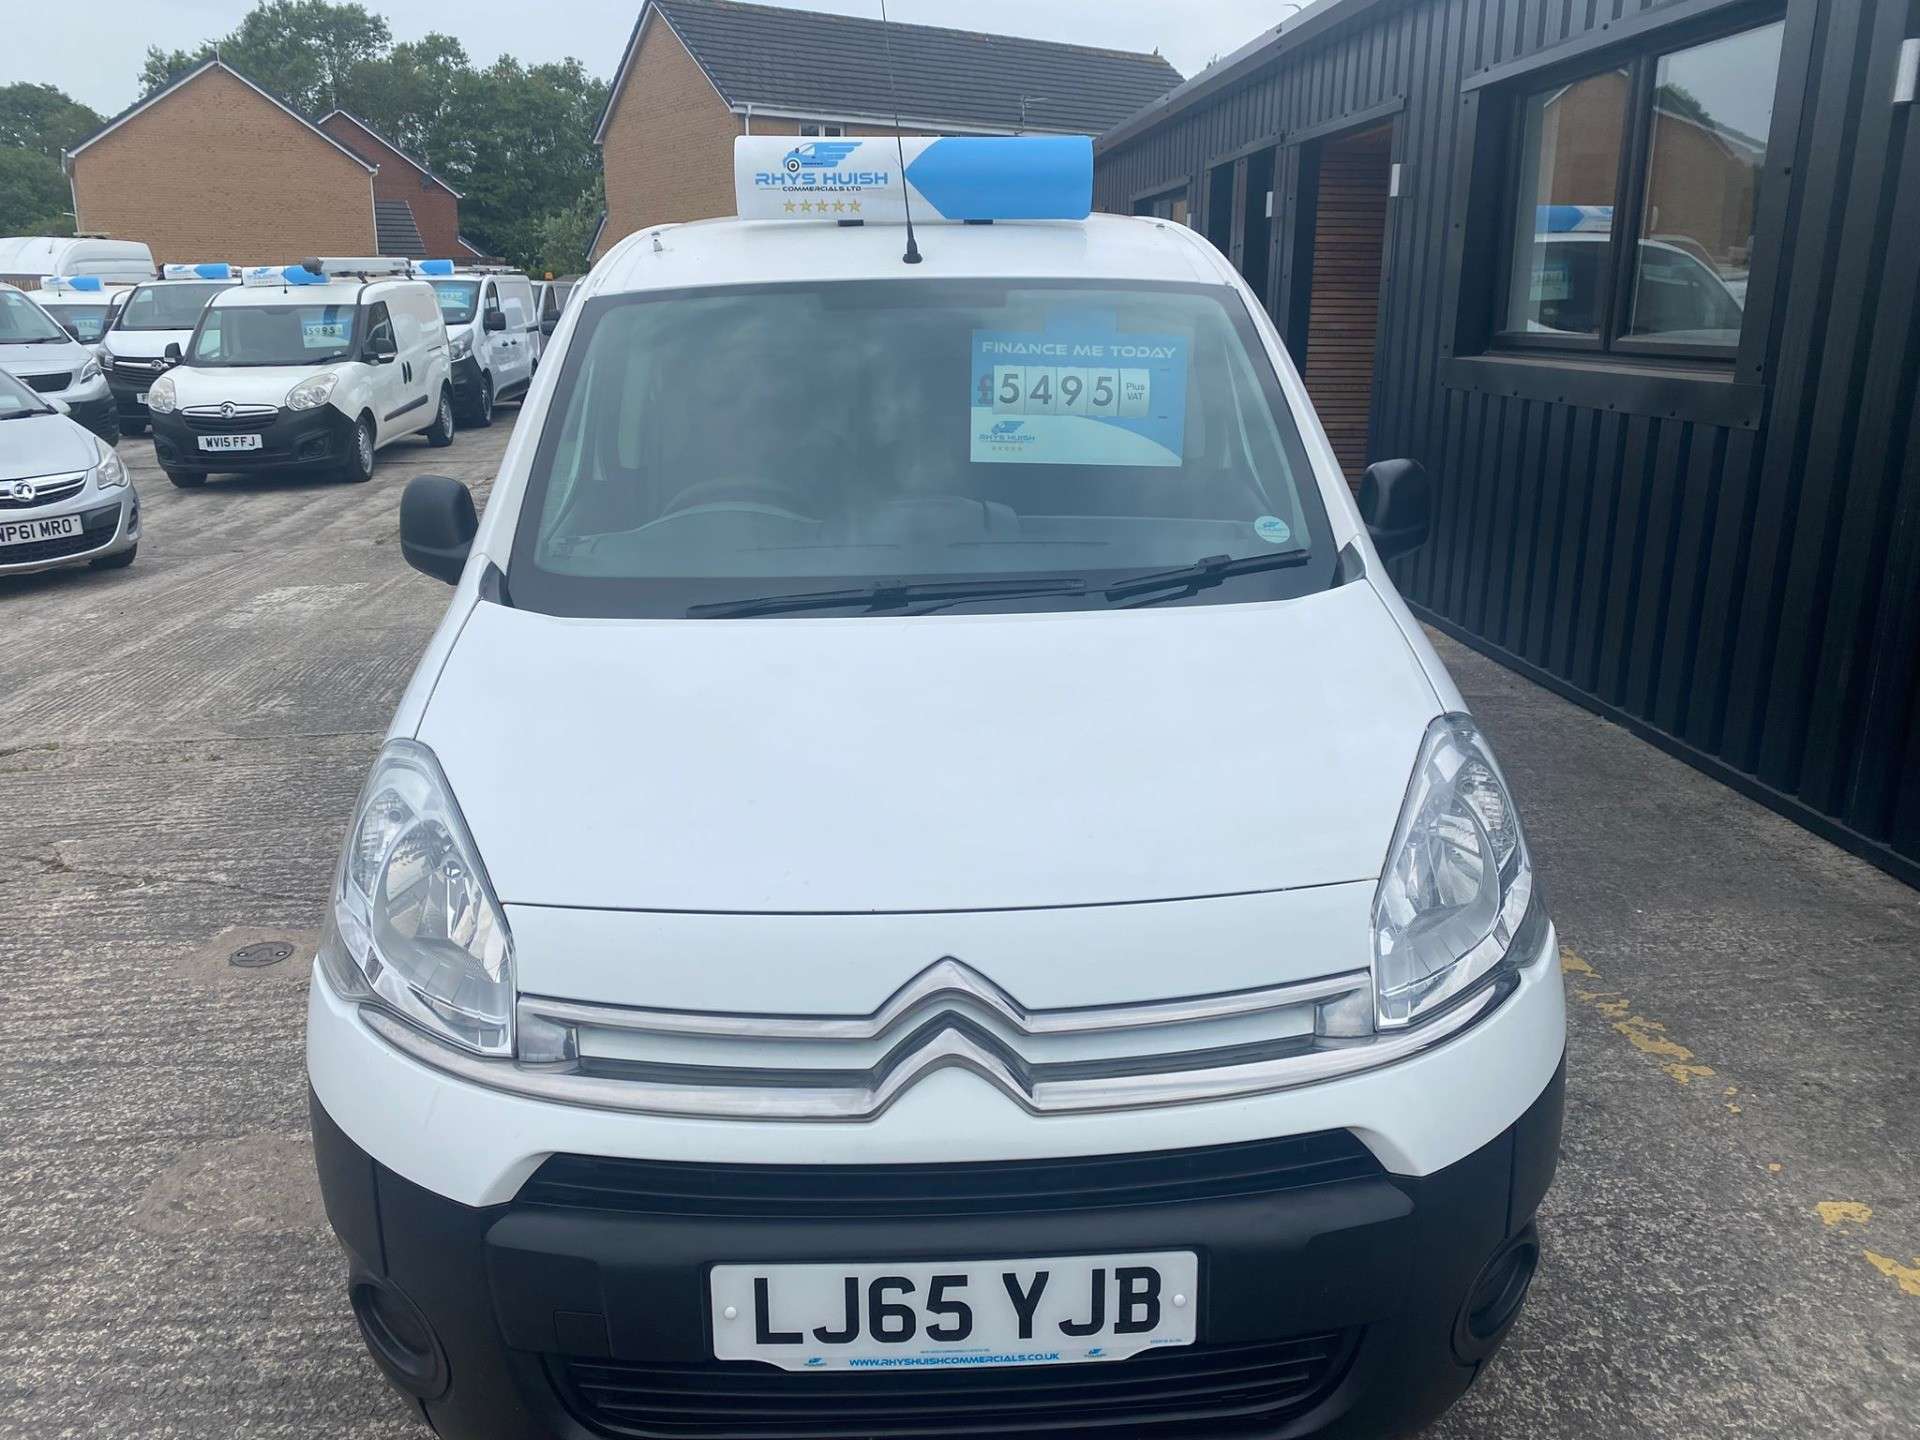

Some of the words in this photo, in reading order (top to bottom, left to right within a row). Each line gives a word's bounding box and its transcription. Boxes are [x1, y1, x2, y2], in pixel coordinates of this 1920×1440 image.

[754, 172, 816, 185] RHYS
[823, 171, 888, 185] HUISH
[982, 341, 1069, 357] FINANCE
[1073, 344, 1104, 358] ME
[1110, 345, 1176, 359] TODAY
[1126, 381, 1146, 391] Plus
[1126, 391, 1145, 401] VAT
[233, 436, 256, 447] FFJ
[39, 518, 73, 537] MRO
[754, 1273, 973, 1345] LJ65
[1002, 1266, 1162, 1340] YJB
[849, 1352, 1060, 1367] WWW.RHYSHUISHCOMMERCIALS.CO.UK
